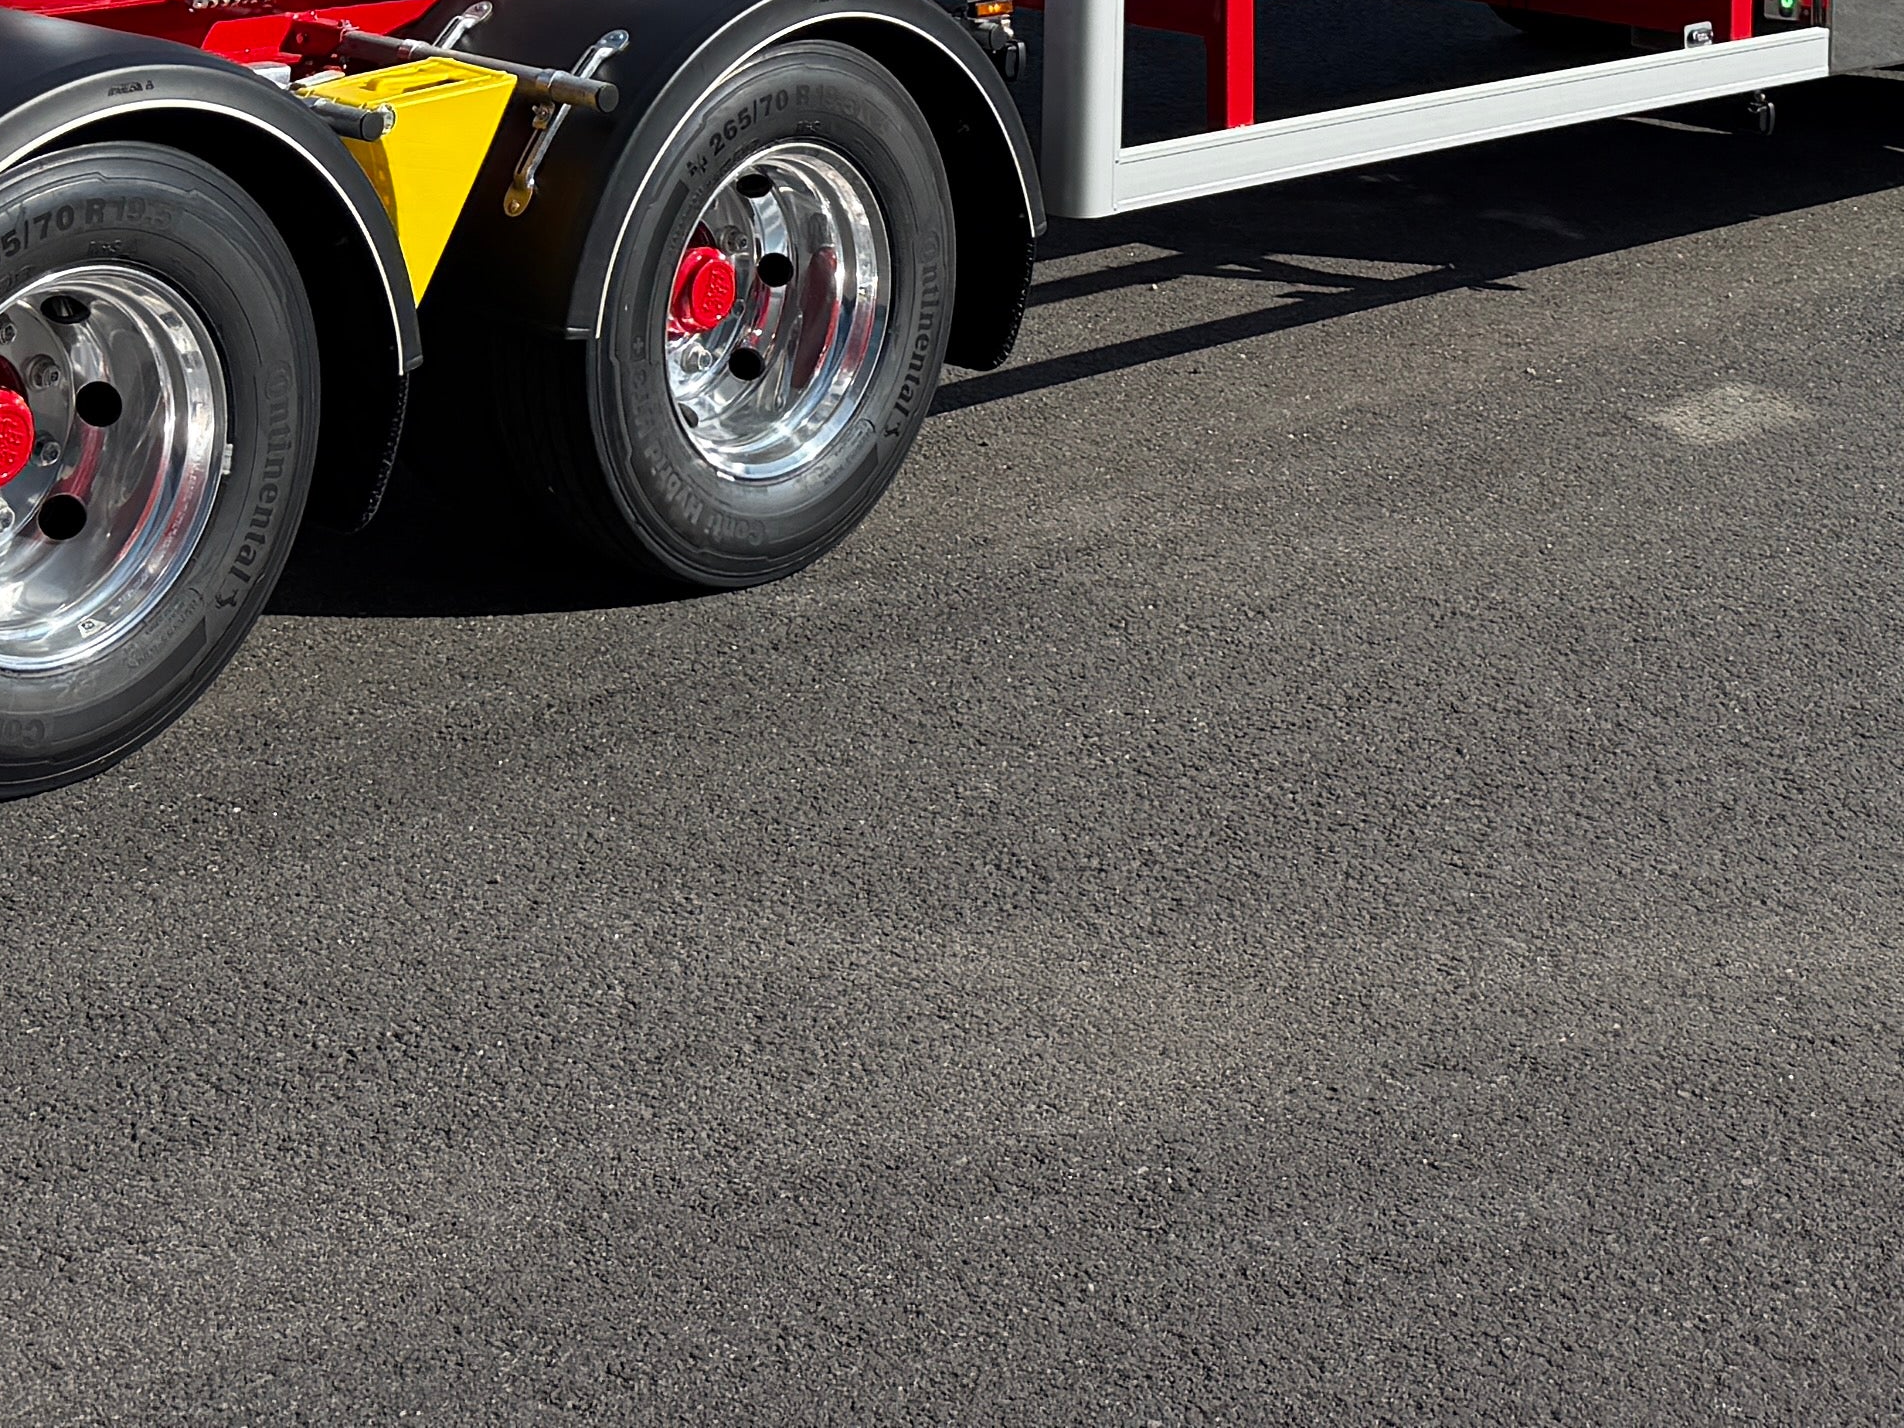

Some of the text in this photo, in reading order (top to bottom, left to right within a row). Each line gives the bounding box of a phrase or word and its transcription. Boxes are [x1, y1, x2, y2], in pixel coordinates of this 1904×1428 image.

[708, 89, 790, 156] 265/70
[84, 197, 105, 225] R
[110, 194, 175, 229] 19.5
[892, 230, 941, 418] Continental
[228, 359, 293, 584] Continental
[644, 441, 704, 525] Hybrid
[703, 511, 766, 547] Conti
